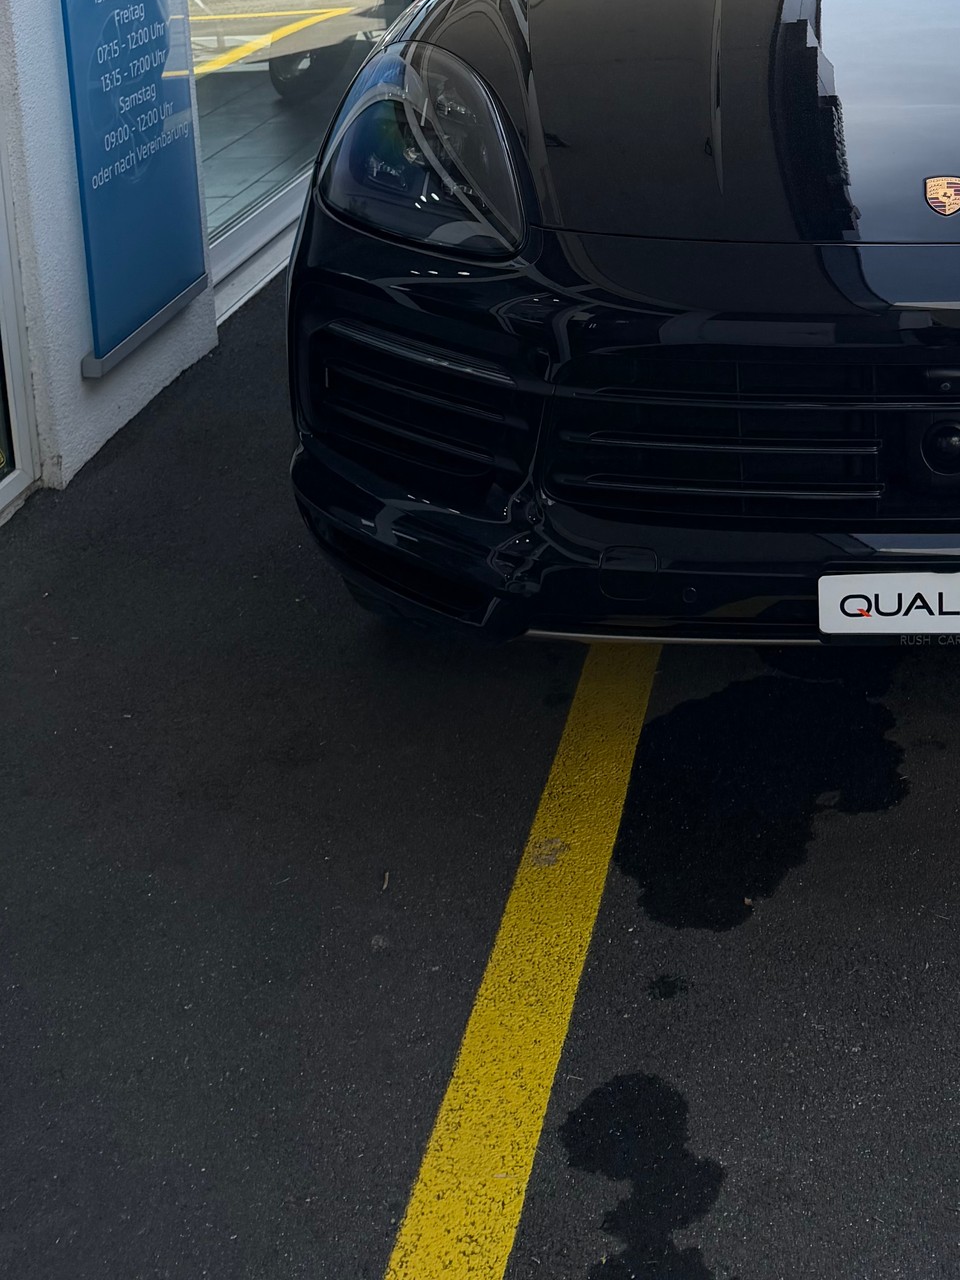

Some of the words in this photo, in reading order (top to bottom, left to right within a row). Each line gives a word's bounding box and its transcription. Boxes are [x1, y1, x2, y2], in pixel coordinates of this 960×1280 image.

[114, 3, 145, 26] Freitag
[97, 40, 120, 64] 07:15
[127, 27, 149, 50] 12:00
[150, 22, 165, 40] Uhr
[100, 68, 122, 92] 13:15
[129, 55, 151, 78] 17:00
[152, 49, 166, 67] Uhr
[119, 83, 156, 114] Samstag
[104, 124, 130, 151] 09:00
[137, 107, 158, 132] 12:00
[160, 101, 174, 120] Uhr
[92, 164, 113, 190] oder
[114, 150, 136, 176] nach
[136, 121, 189, 161] Vereinbarung
[900, 635, 931, 646] RUSH
